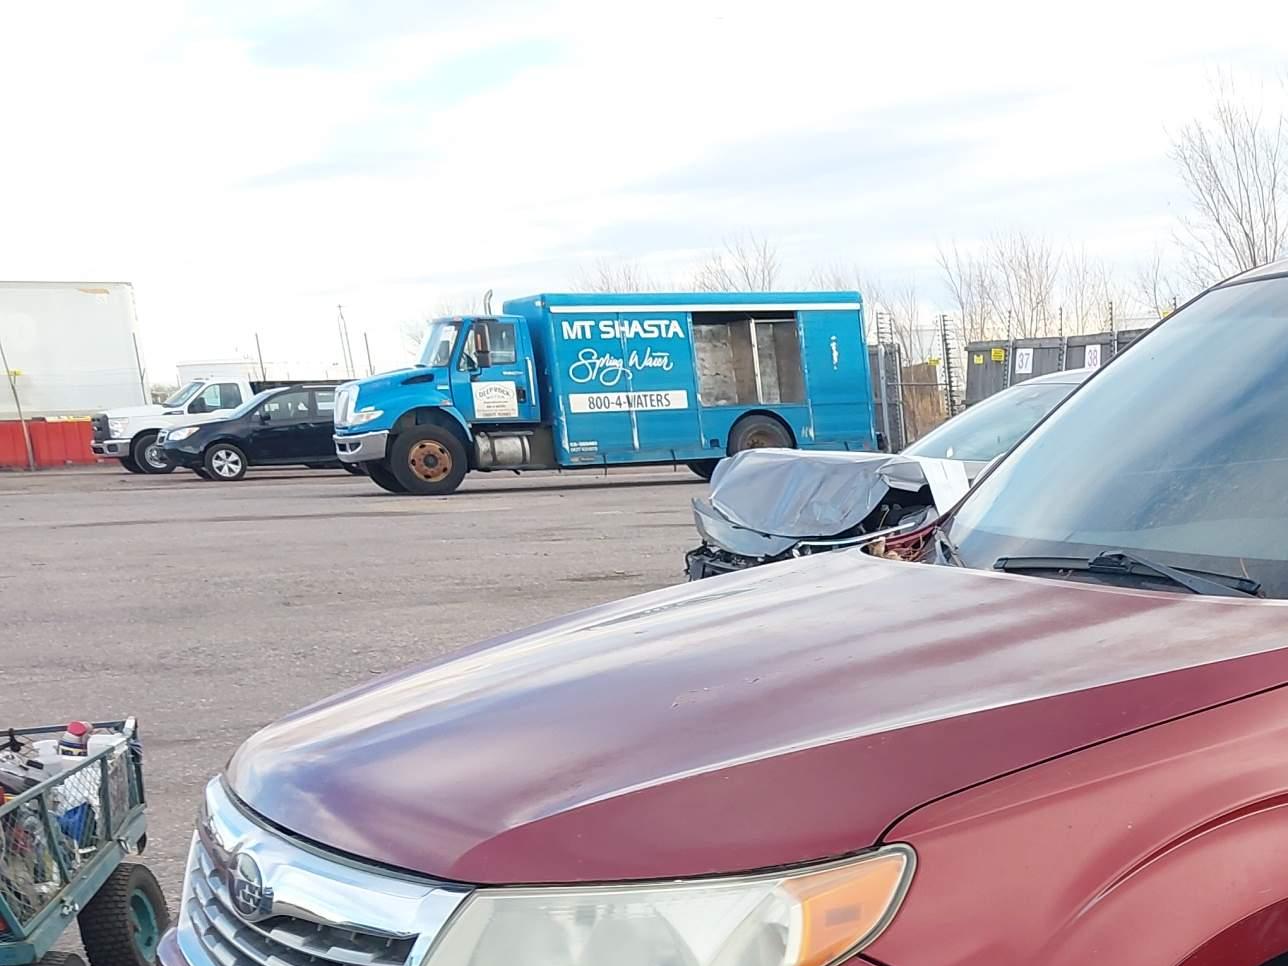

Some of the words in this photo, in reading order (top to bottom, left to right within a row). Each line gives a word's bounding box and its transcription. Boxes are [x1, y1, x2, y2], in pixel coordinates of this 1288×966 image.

[561, 320, 595, 340] MT
[598, 319, 685, 339] SHASTA
[569, 348, 633, 386] Spring
[628, 346, 674, 371] Water
[1018, 351, 1031, 369] 37
[587, 393, 671, 410] 800-4-WATERS
